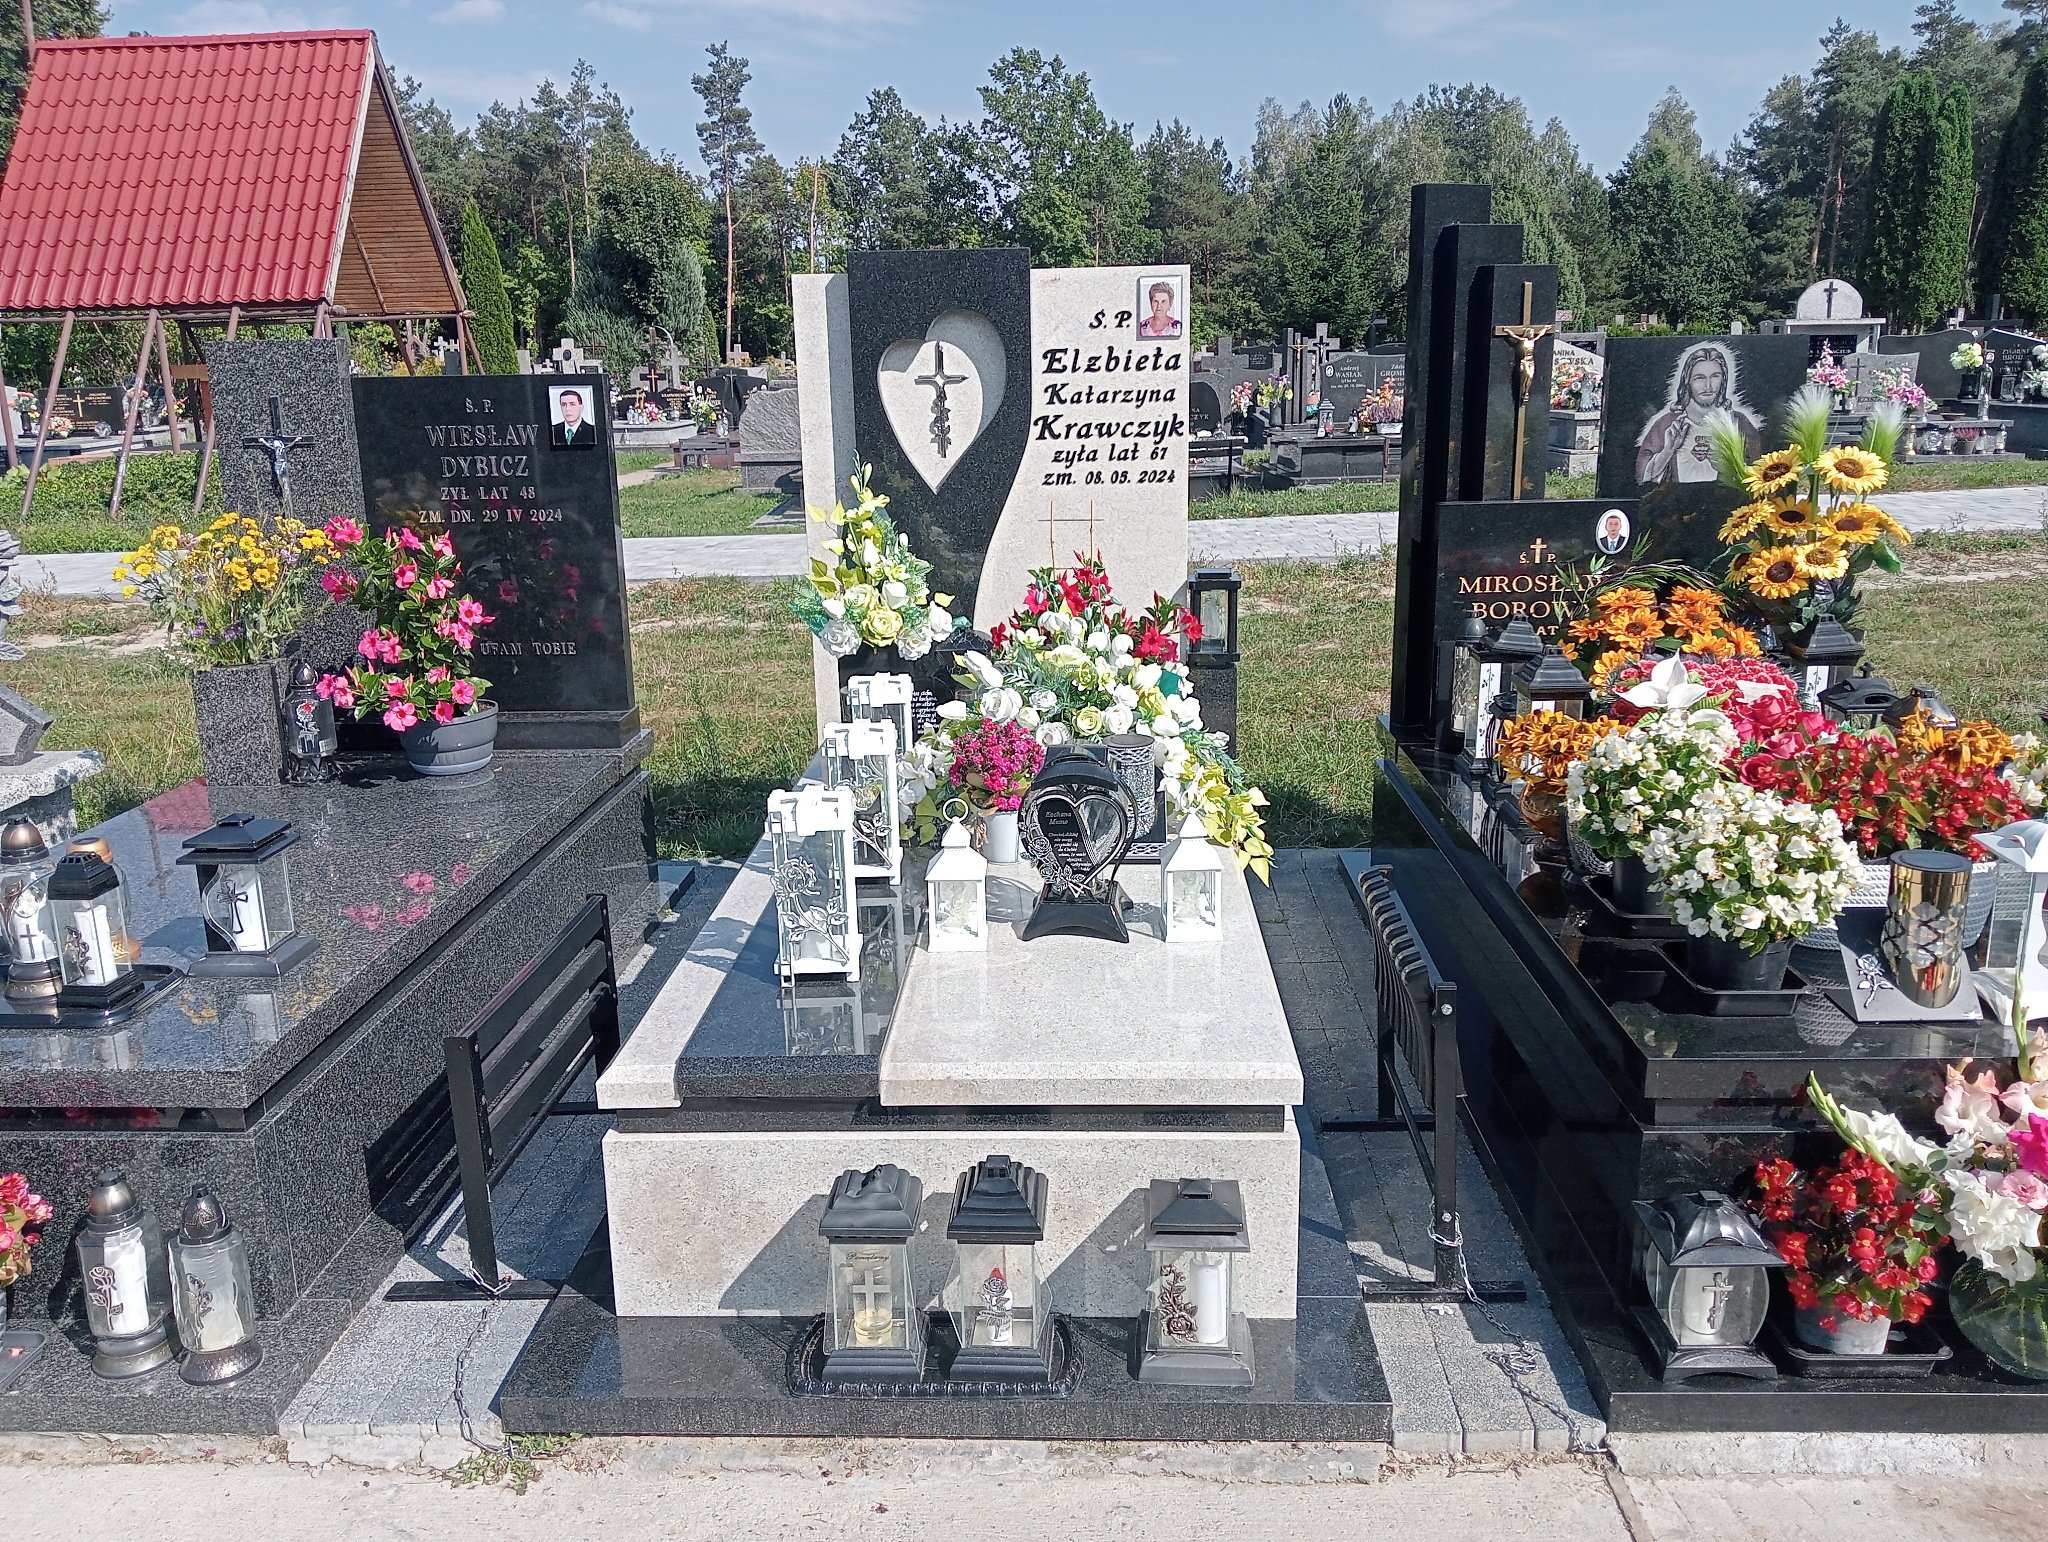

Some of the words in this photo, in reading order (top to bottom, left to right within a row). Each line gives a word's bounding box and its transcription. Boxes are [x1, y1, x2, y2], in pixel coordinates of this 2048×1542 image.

[1114, 310, 1132, 329] P.
[1044, 383, 1176, 409] Katarzyna
[483, 399, 494, 413] P.
[424, 424, 539, 447] WIESŁAW
[1033, 413, 1185, 445] Krawczyk
[1108, 442, 1139, 461] lat
[1150, 446, 1168, 460] 67
[440, 455, 529, 478] DYBICZ
[1041, 471, 1076, 486] zm.
[1085, 470, 1104, 485] 08.
[1110, 470, 1131, 484] 05.
[1136, 469, 1176, 484] 2024
[479, 486, 509, 500] LAT
[519, 486, 536, 500] 48
[419, 510, 446, 524] ZM.
[450, 509, 476, 523] DN.
[482, 509, 499, 522] 29
[506, 509, 523, 522] IV
[529, 508, 562, 522] 2024
[1546, 553, 1556, 563] P.
[480, 642, 522, 655] UFAM
[532, 642, 577, 655] TOBIE
